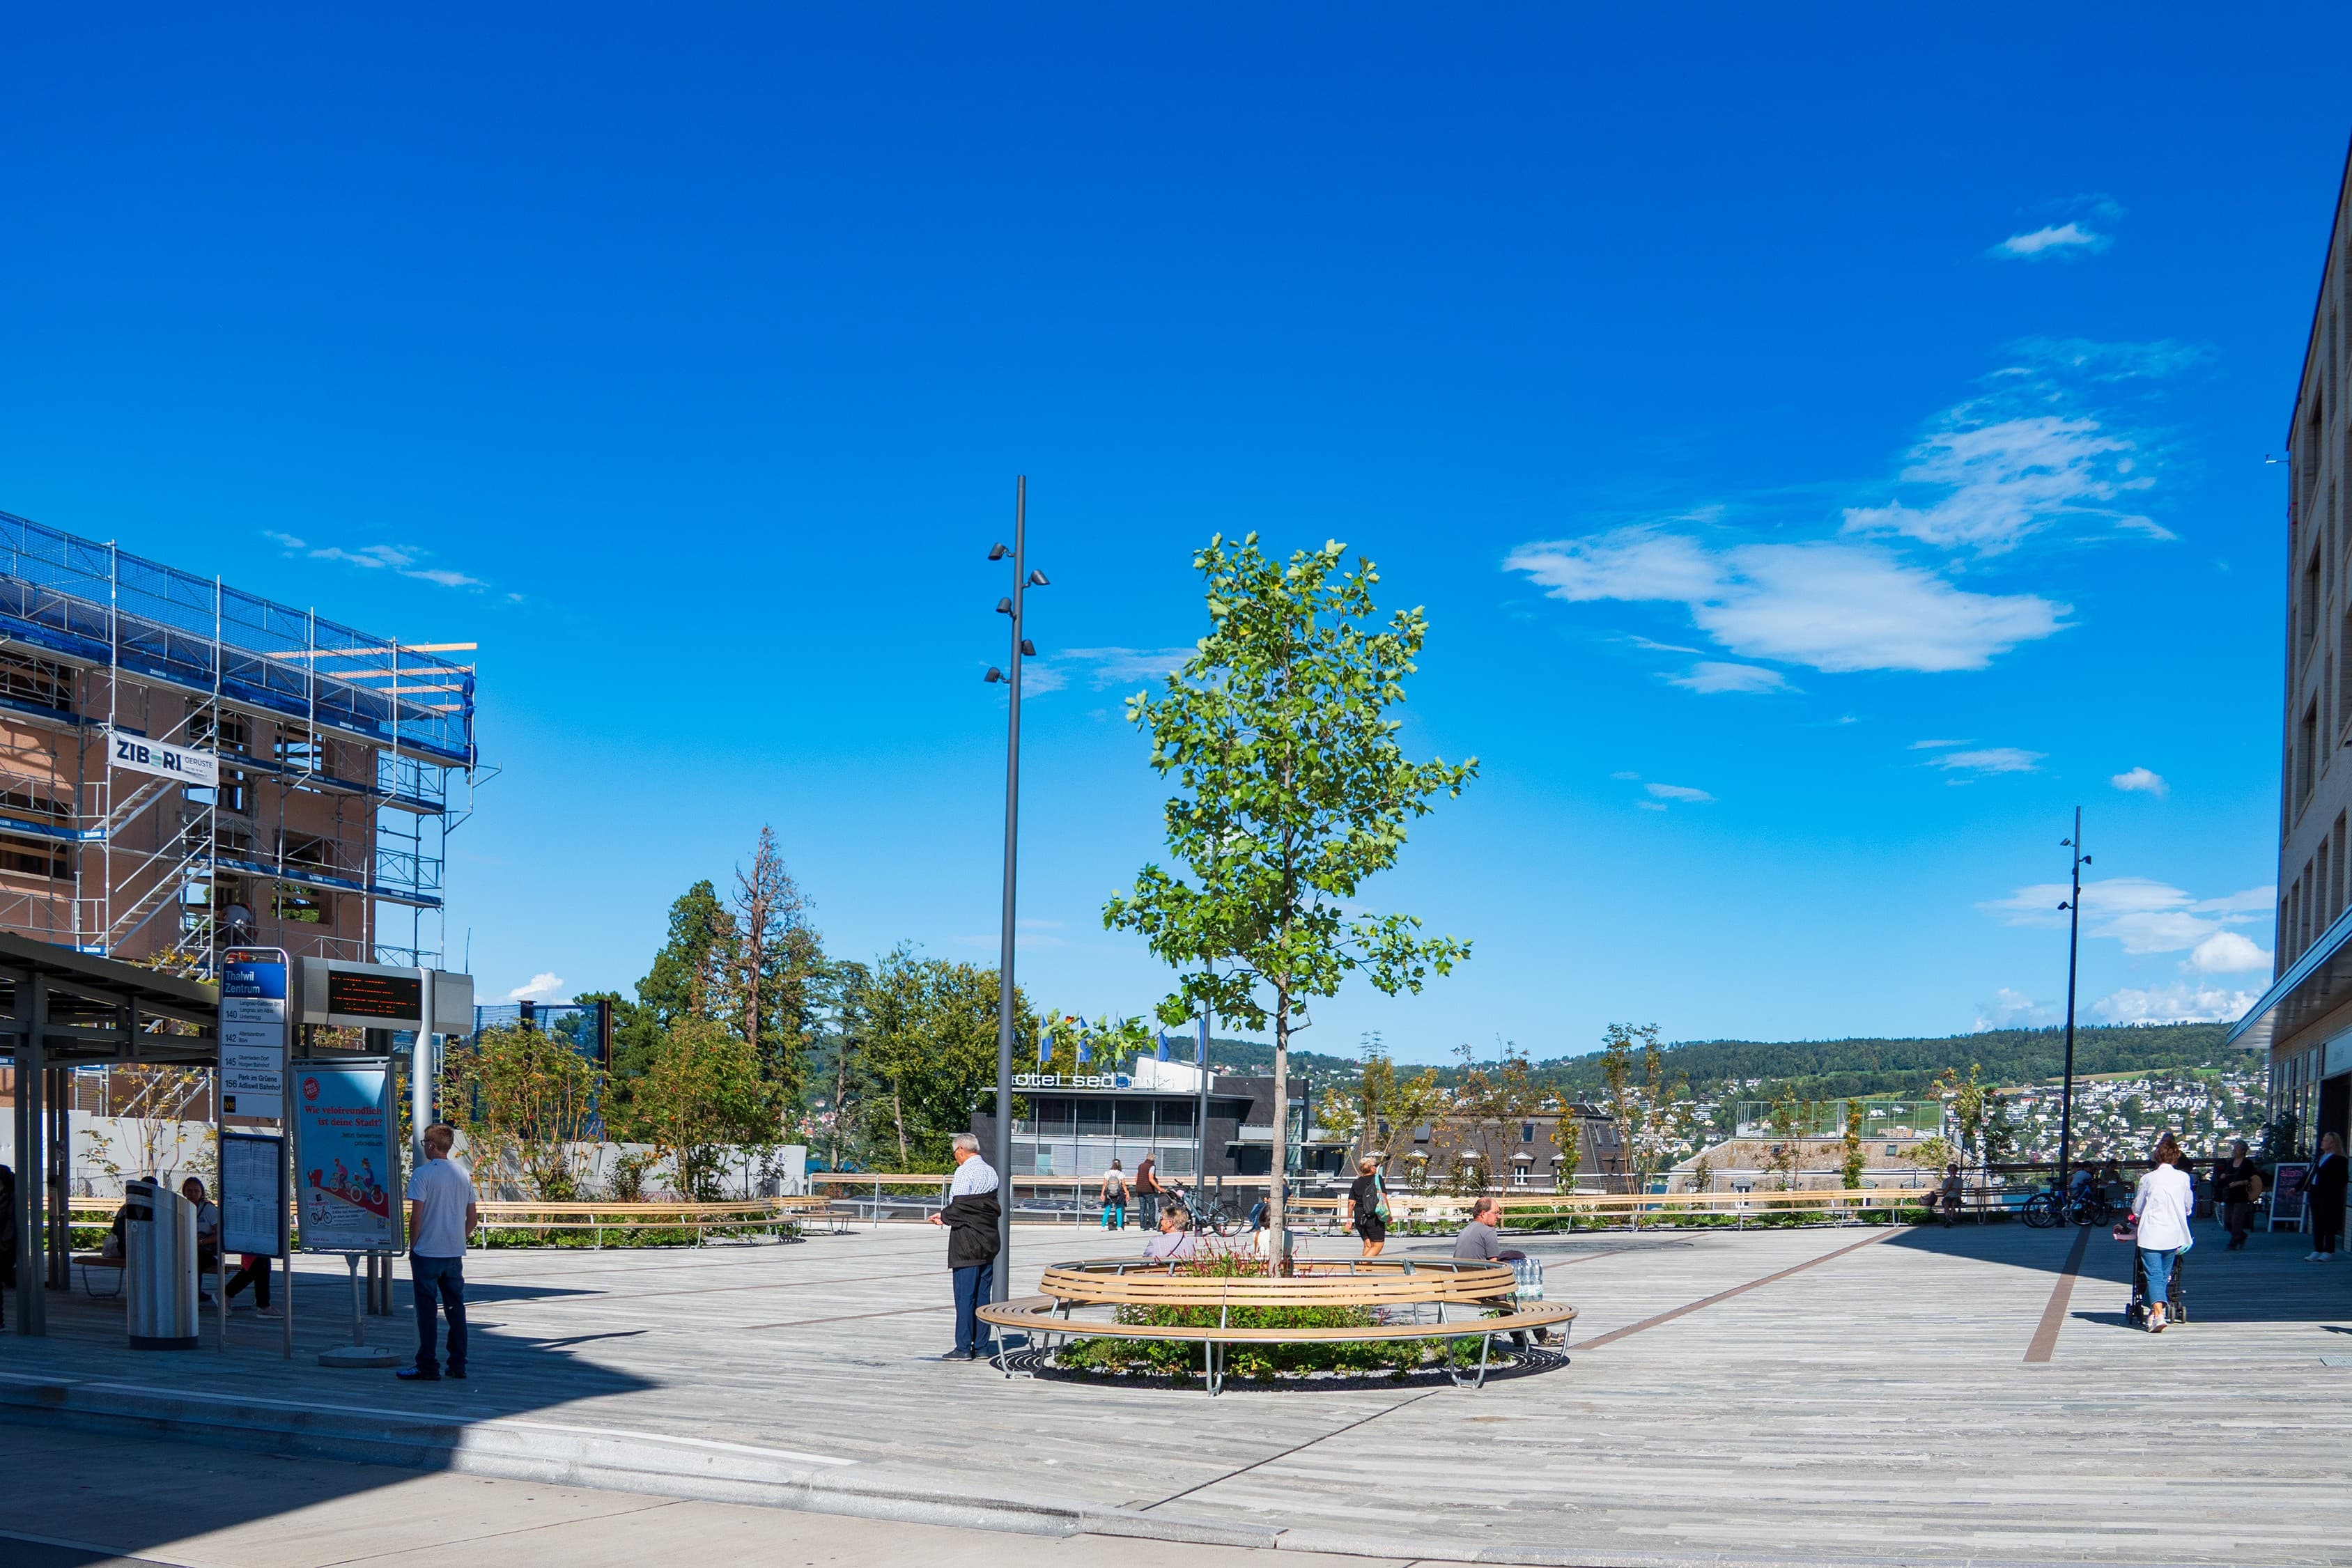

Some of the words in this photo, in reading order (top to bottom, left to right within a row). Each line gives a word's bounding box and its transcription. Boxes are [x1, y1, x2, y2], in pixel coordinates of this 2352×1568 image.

[185, 756, 213, 769] GERÜSTE
[225, 970, 254, 981] Thalwil
[225, 983, 260, 994] Zentrum
[226, 1010, 237, 1018] 140
[225, 1034, 236, 1043] 142
[225, 1057, 236, 1066] 145
[225, 1080, 238, 1088] 156
[304, 1105, 319, 1114] Wie
[322, 1105, 382, 1115] velofreundlich
[318, 1117, 328, 1126] ist
[331, 1118, 353, 1126] deine
[355, 1118, 382, 1126] Stadt?
